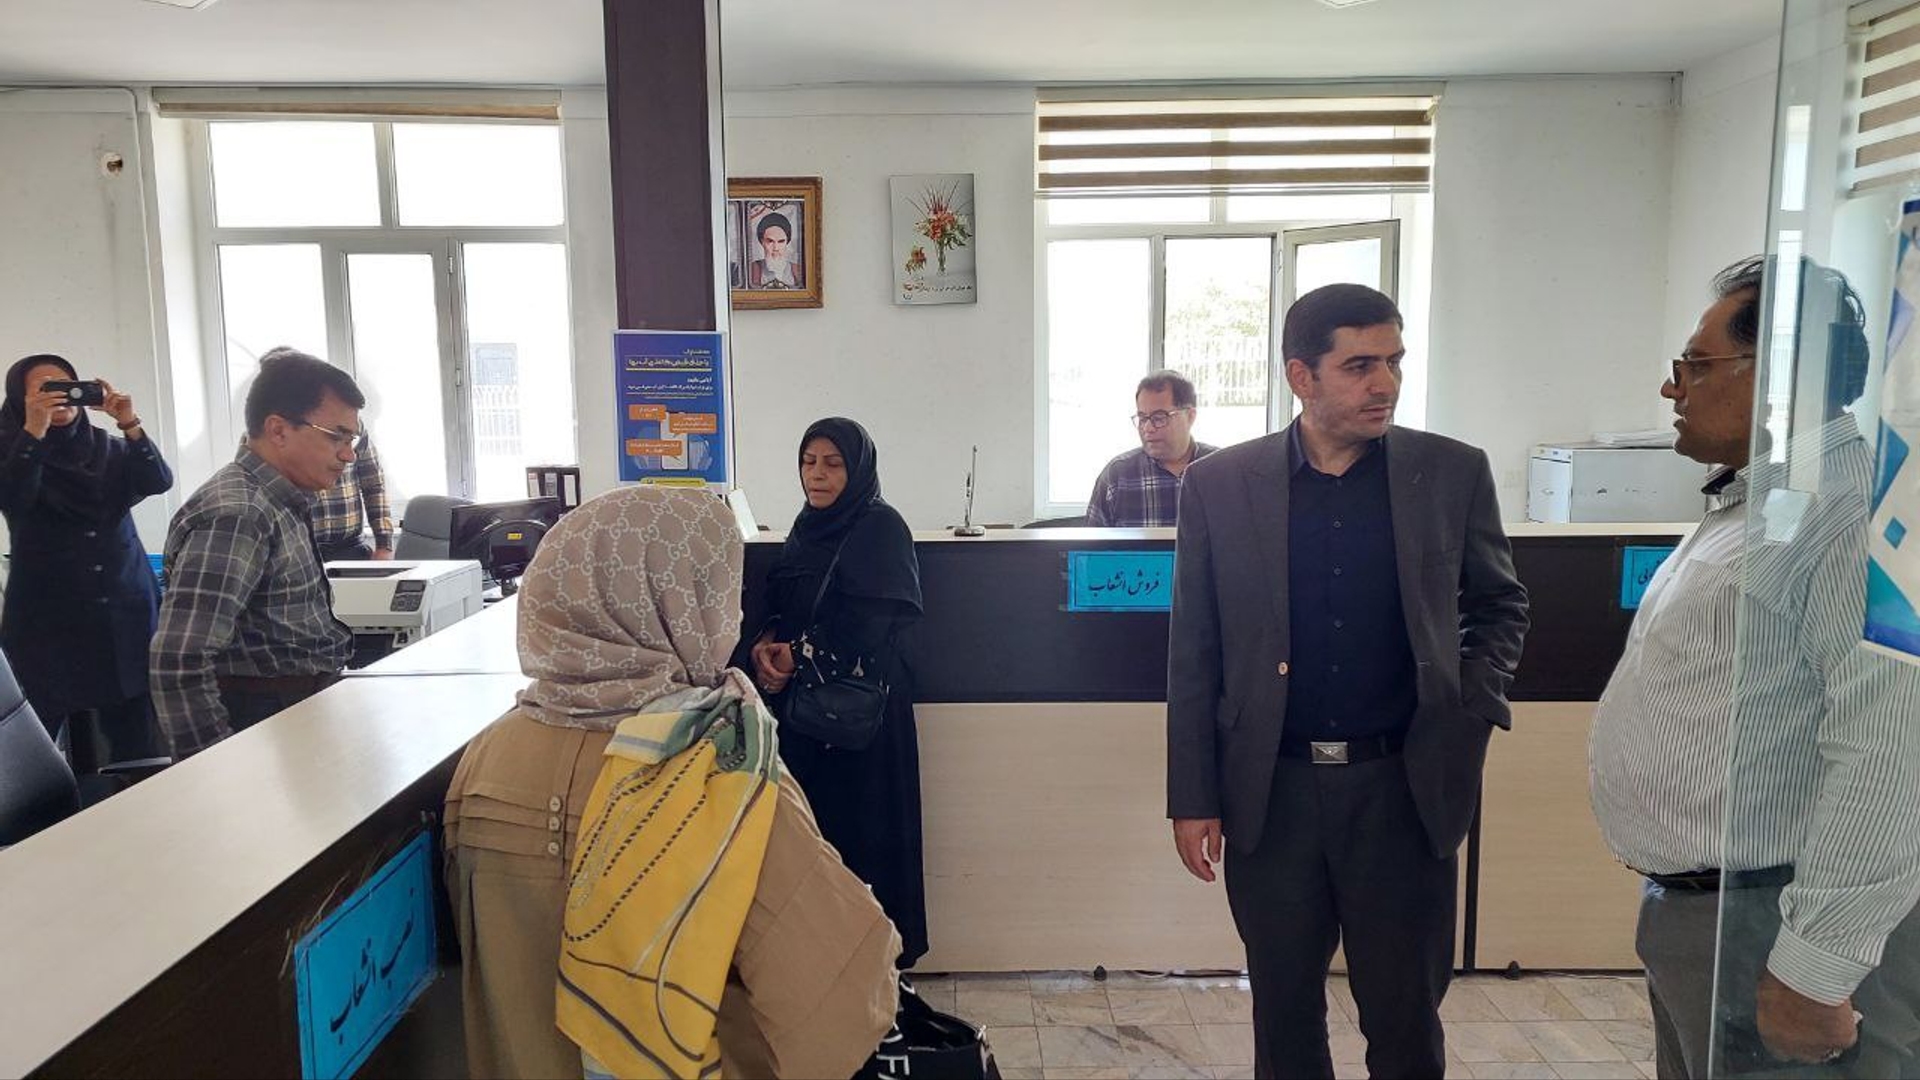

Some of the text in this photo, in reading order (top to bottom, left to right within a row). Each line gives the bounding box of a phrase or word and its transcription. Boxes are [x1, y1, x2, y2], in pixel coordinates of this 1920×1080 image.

[1088, 568, 1160, 597] فروش انشعاب
[329, 886, 415, 1045] نصب انشعاب
